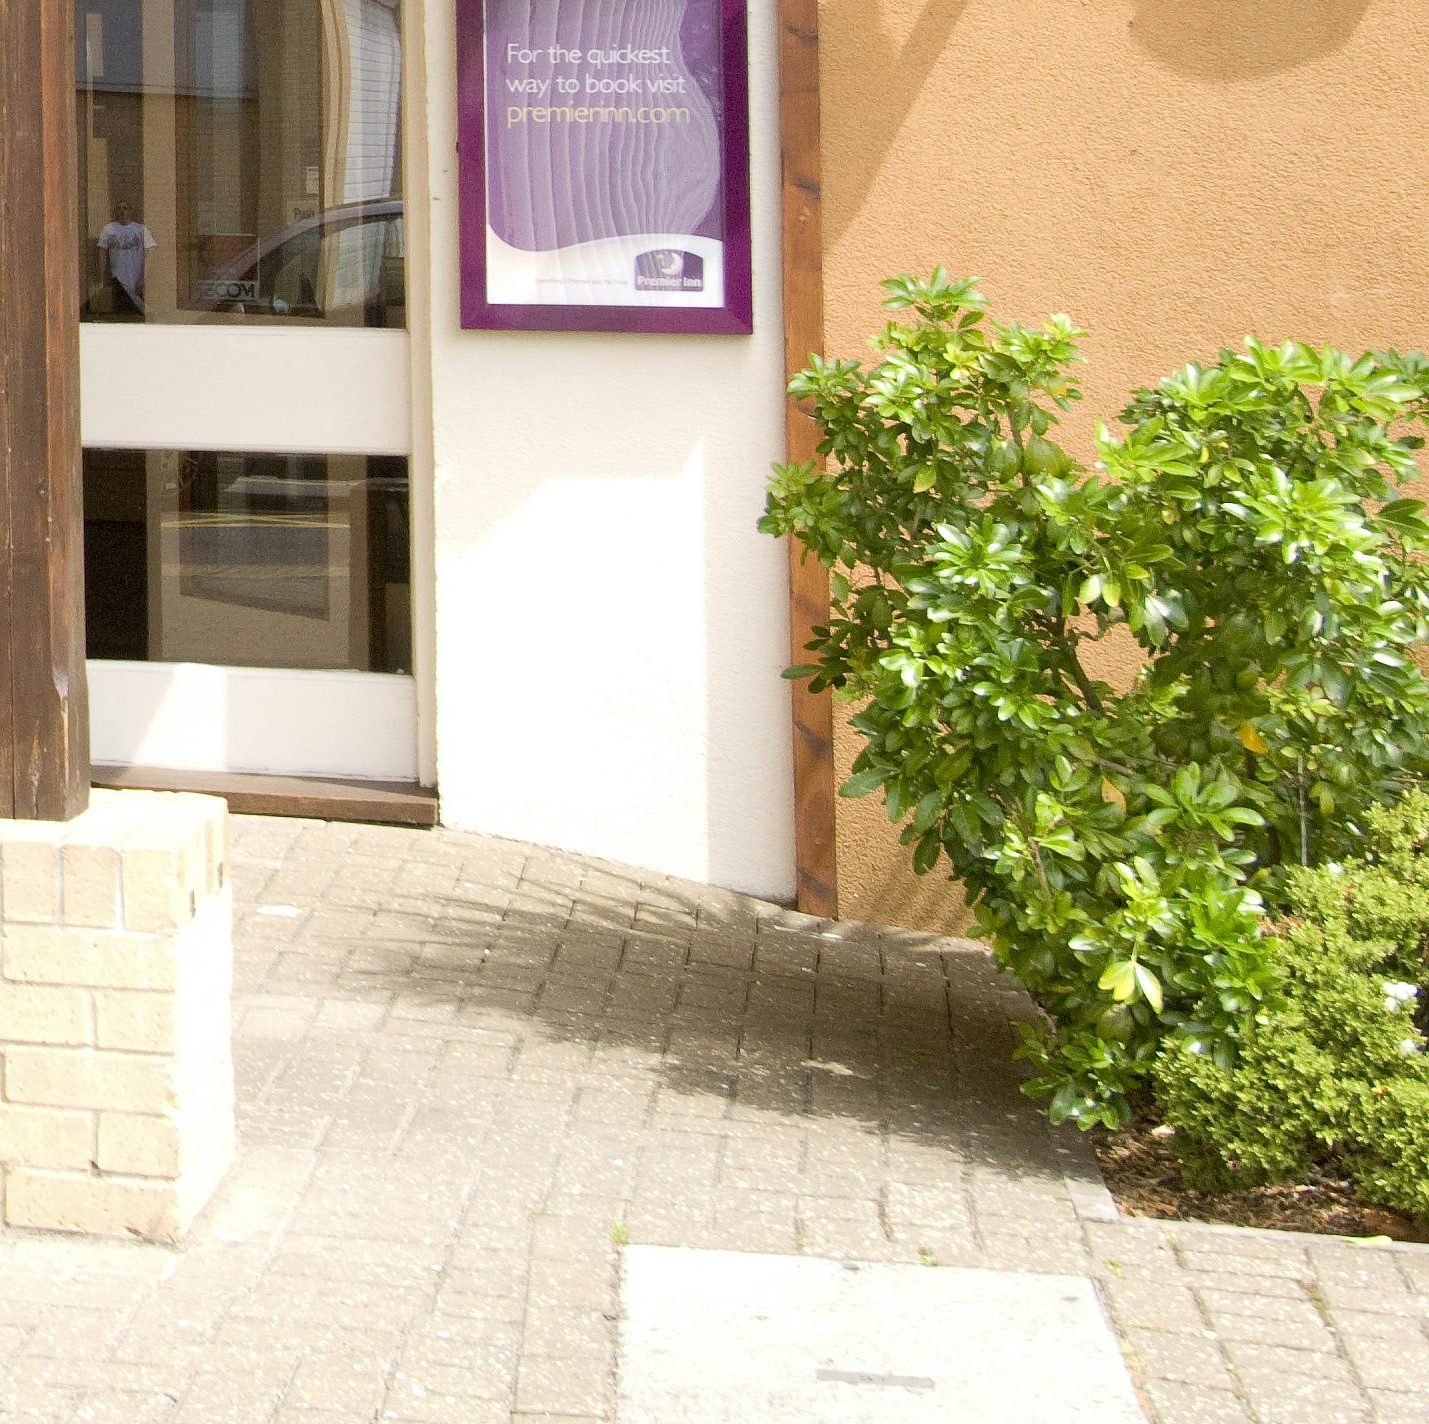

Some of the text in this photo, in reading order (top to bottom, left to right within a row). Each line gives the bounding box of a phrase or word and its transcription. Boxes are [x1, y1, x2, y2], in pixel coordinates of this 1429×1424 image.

[507, 43, 671, 69] For the quickest
[506, 73, 687, 98] way to book visit
[507, 99, 690, 129] premierinn.com
[636, 275, 682, 287] Premier
[683, 276, 702, 288] Inn
